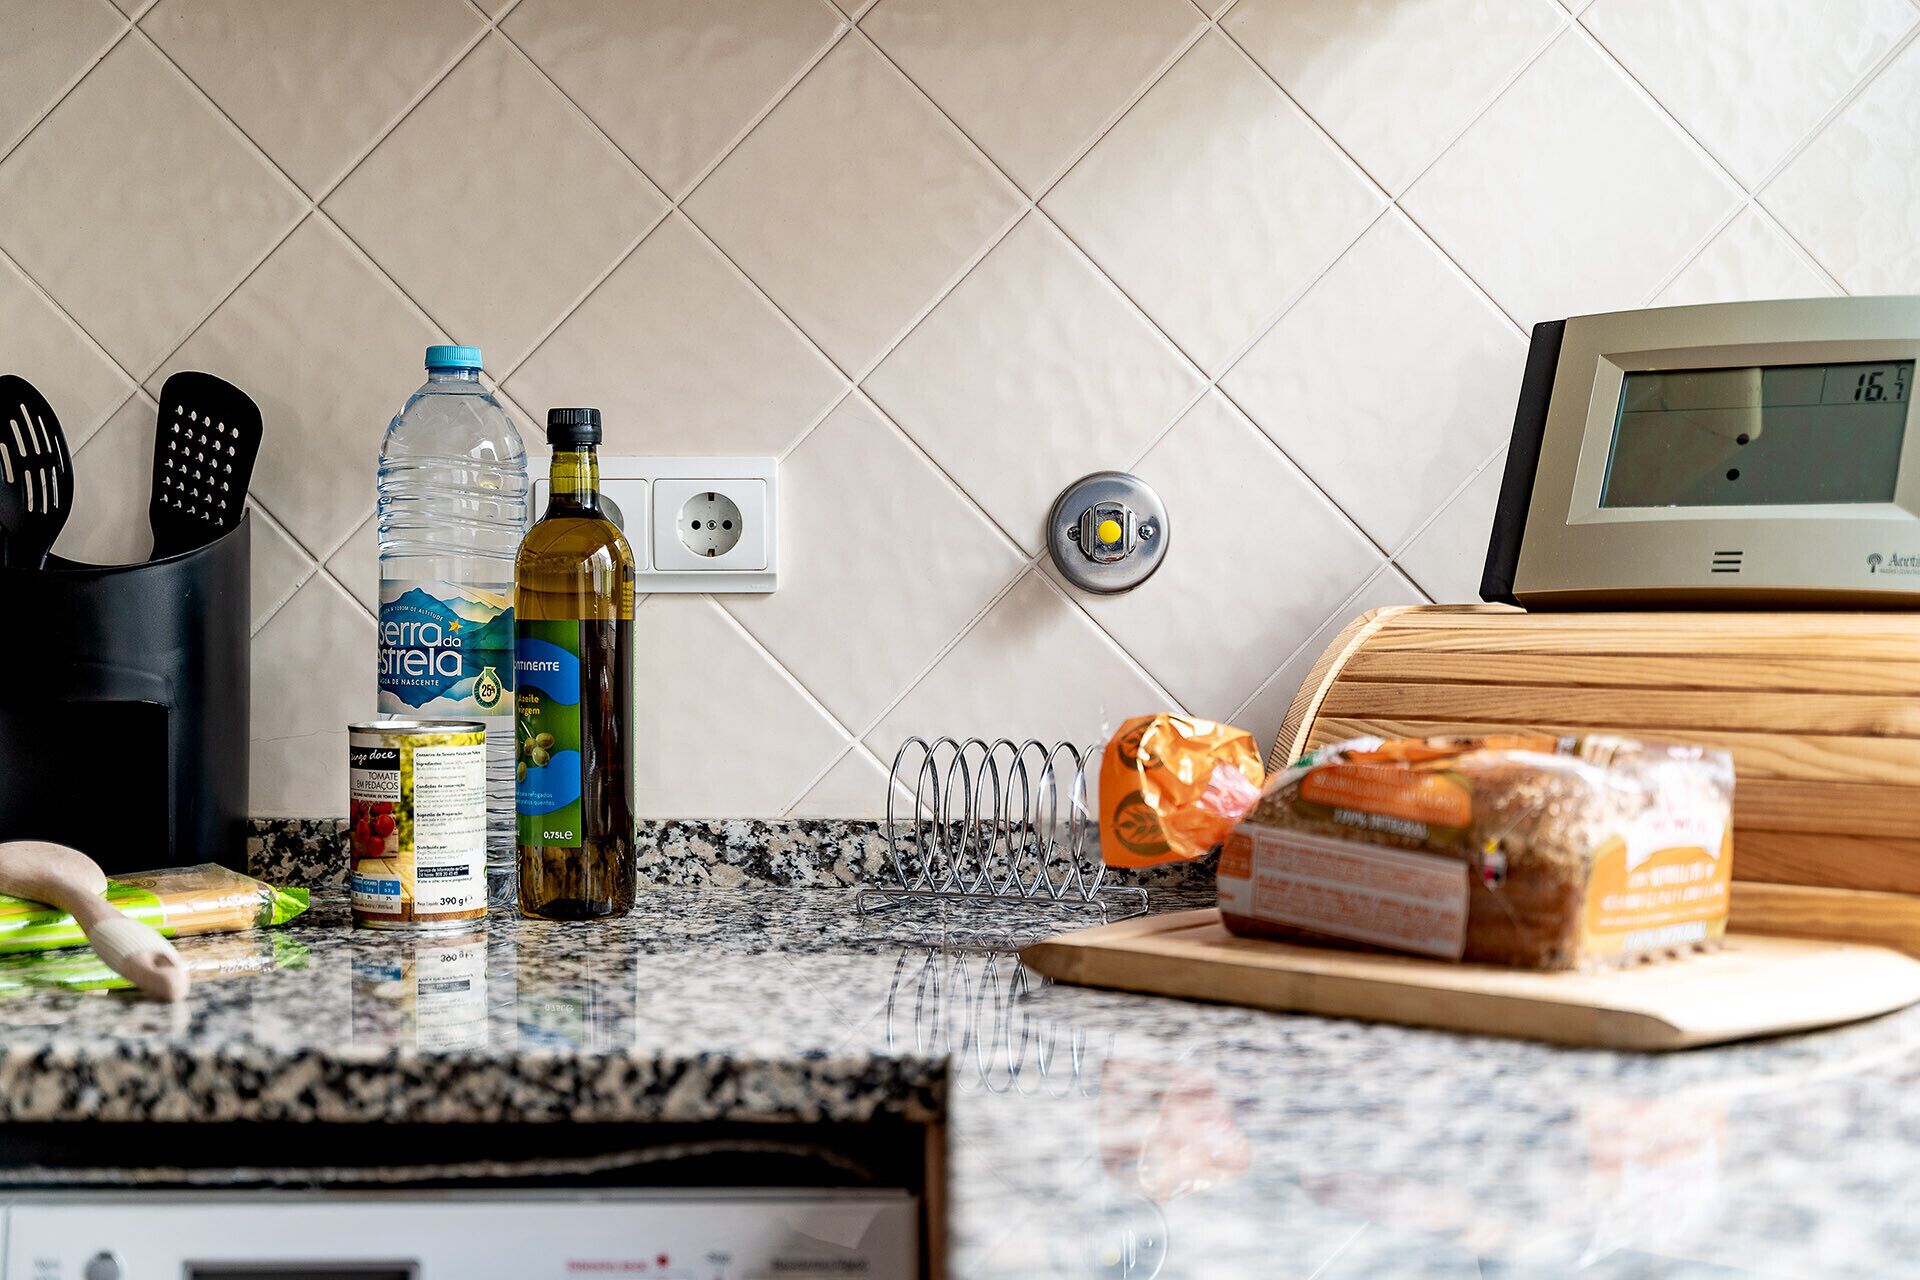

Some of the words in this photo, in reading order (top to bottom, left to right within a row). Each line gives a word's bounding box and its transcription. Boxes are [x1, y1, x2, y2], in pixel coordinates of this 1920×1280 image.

[418, 609, 444, 621] ALTITUDE
[379, 621, 442, 647] serra
[443, 635, 462, 647] da
[369, 749, 397, 760] doce
[368, 772, 398, 780] TOMATE
[356, 780, 365, 789] EM
[365, 781, 399, 791] PEDAÇOS
[440, 896, 457, 906] 390
[458, 898, 464, 907] g
